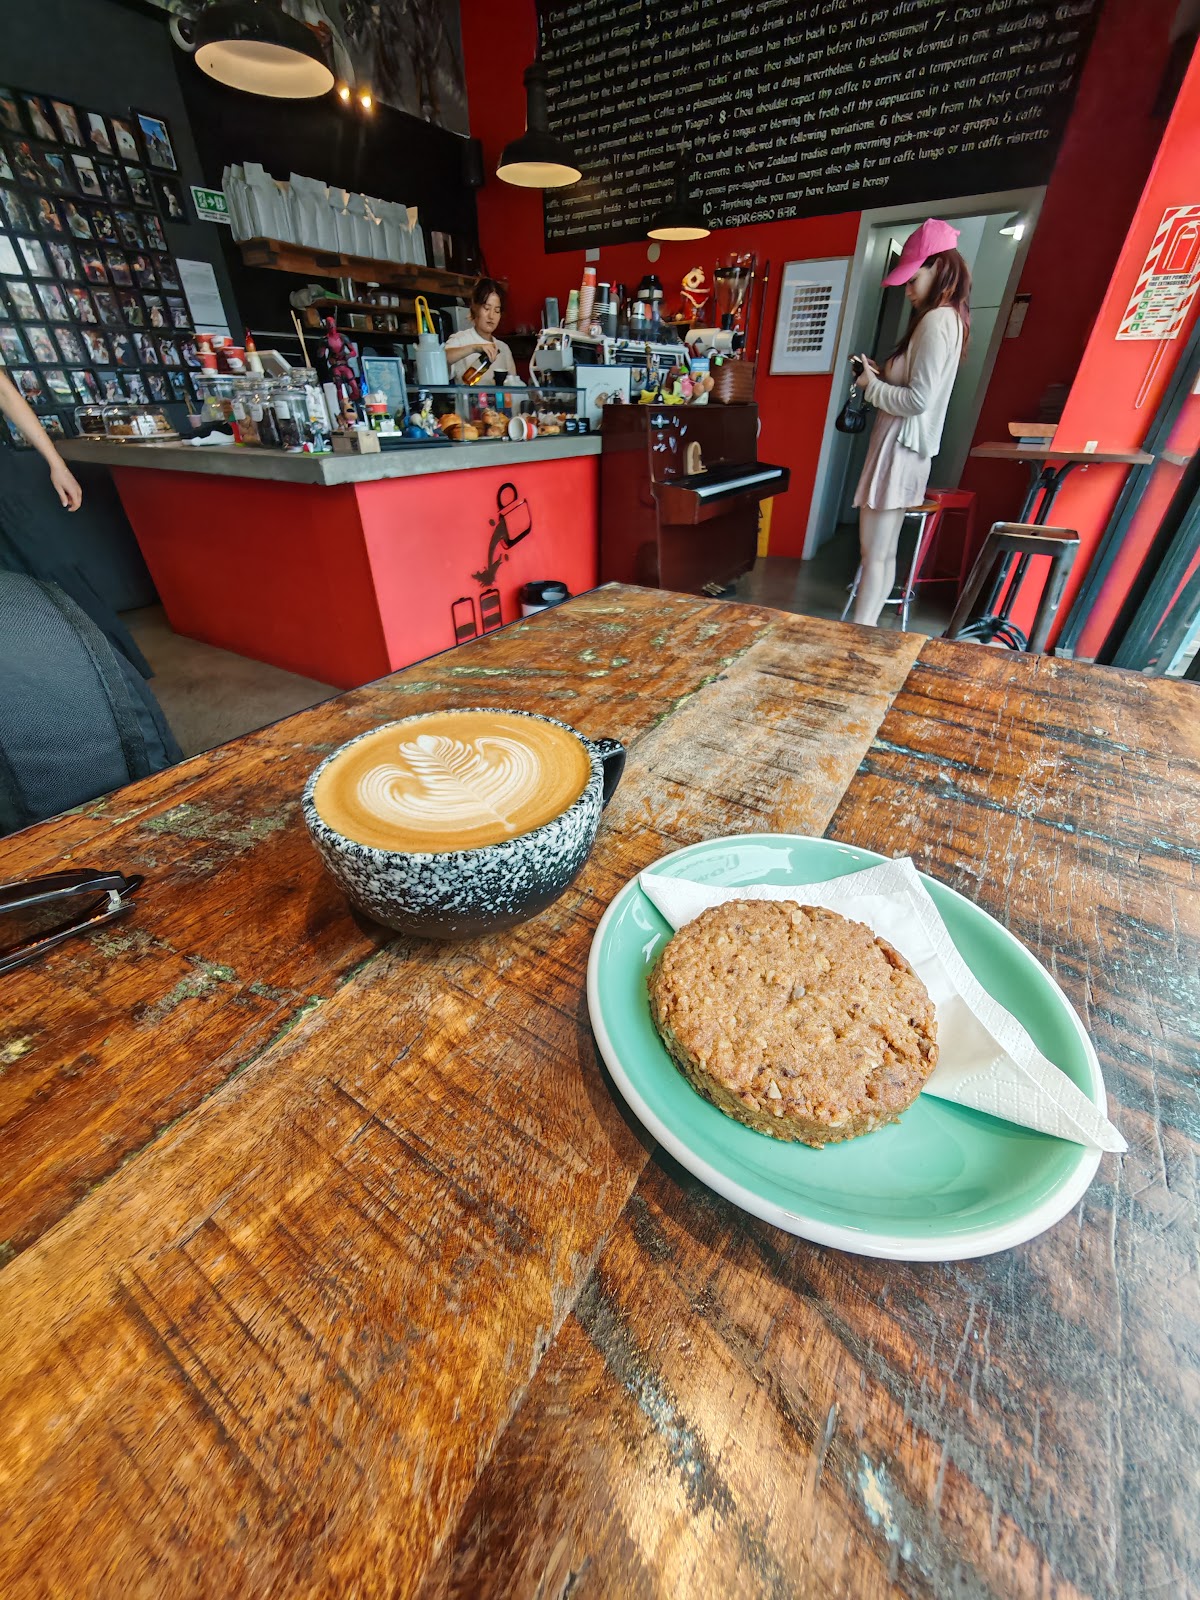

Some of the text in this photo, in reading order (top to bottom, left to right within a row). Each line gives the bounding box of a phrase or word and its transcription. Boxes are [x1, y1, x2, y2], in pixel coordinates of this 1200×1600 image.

[721, 52, 733, 64] the
[805, 24, 825, 41] back
[828, 24, 838, 34] to
[840, 17, 857, 33] you
[870, 9, 889, 26] pay
[749, 23, 760, 36] do
[795, 9, 807, 22] lot
[809, 3, 820, 18] of
[732, 70, 742, 80] at
[763, 60, 782, 73] thou
[783, 51, 805, 67] shalt
[806, 49, 824, 64] pay
[826, 40, 852, 56] before
[855, 34, 876, 49] thou
[757, 82, 771, 94] but
[780, 76, 801, 88] drug
[869, 47, 900, 66] should
[902, 46, 913, 58] be
[916, 33, 954, 55] downed
[957, 33, 969, 44] in
[817, 87, 832, 99] thy
[834, 80, 859, 96] coffee
[861, 79, 871, 89] to
[904, 67, 916, 80] at
[929, 52, 989, 74] temperature
[992, 46, 1004, 59] at
[734, 145, 743, 155] be
[744, 137, 774, 153] allowed
[775, 135, 788, 147] the
[789, 128, 827, 144] following
[891, 111, 913, 124] these
[916, 104, 937, 119] only
[940, 101, 964, 114] from
[968, 95, 983, 109] the
[758, 123, 768, 132] or
[769, 114, 801, 130] blowing
[803, 110, 816, 122] the
[818, 104, 840, 119] froth
[841, 100, 856, 114] off
[858, 98, 873, 112] thy
[874, 87, 925, 108] cappuccino
[928, 83, 939, 96] in
[953, 77, 976, 90] vain
[978, 66, 1021, 84] attempt
[734, 162, 745, 173] the
[747, 160, 765, 170] New
[766, 151, 798, 168] Zealand
[830, 141, 852, 156] early
[853, 135, 891, 151] morning
[893, 126, 946, 146] pick-me-up
[948, 123, 960, 134] or
[961, 116, 999, 134] grappa
[824, 163, 842, 175] also
[844, 159, 860, 172] ask
[862, 157, 877, 169] for
[878, 156, 891, 166] un
[918, 146, 944, 160] lungo
[947, 144, 958, 154] or
[961, 141, 975, 152] un
[725, 208, 775, 227] ESPRESSO
[769, 193, 784, 205] you
[785, 189, 804, 200] may
[805, 186, 824, 196] have
[826, 179, 850, 194] heard
